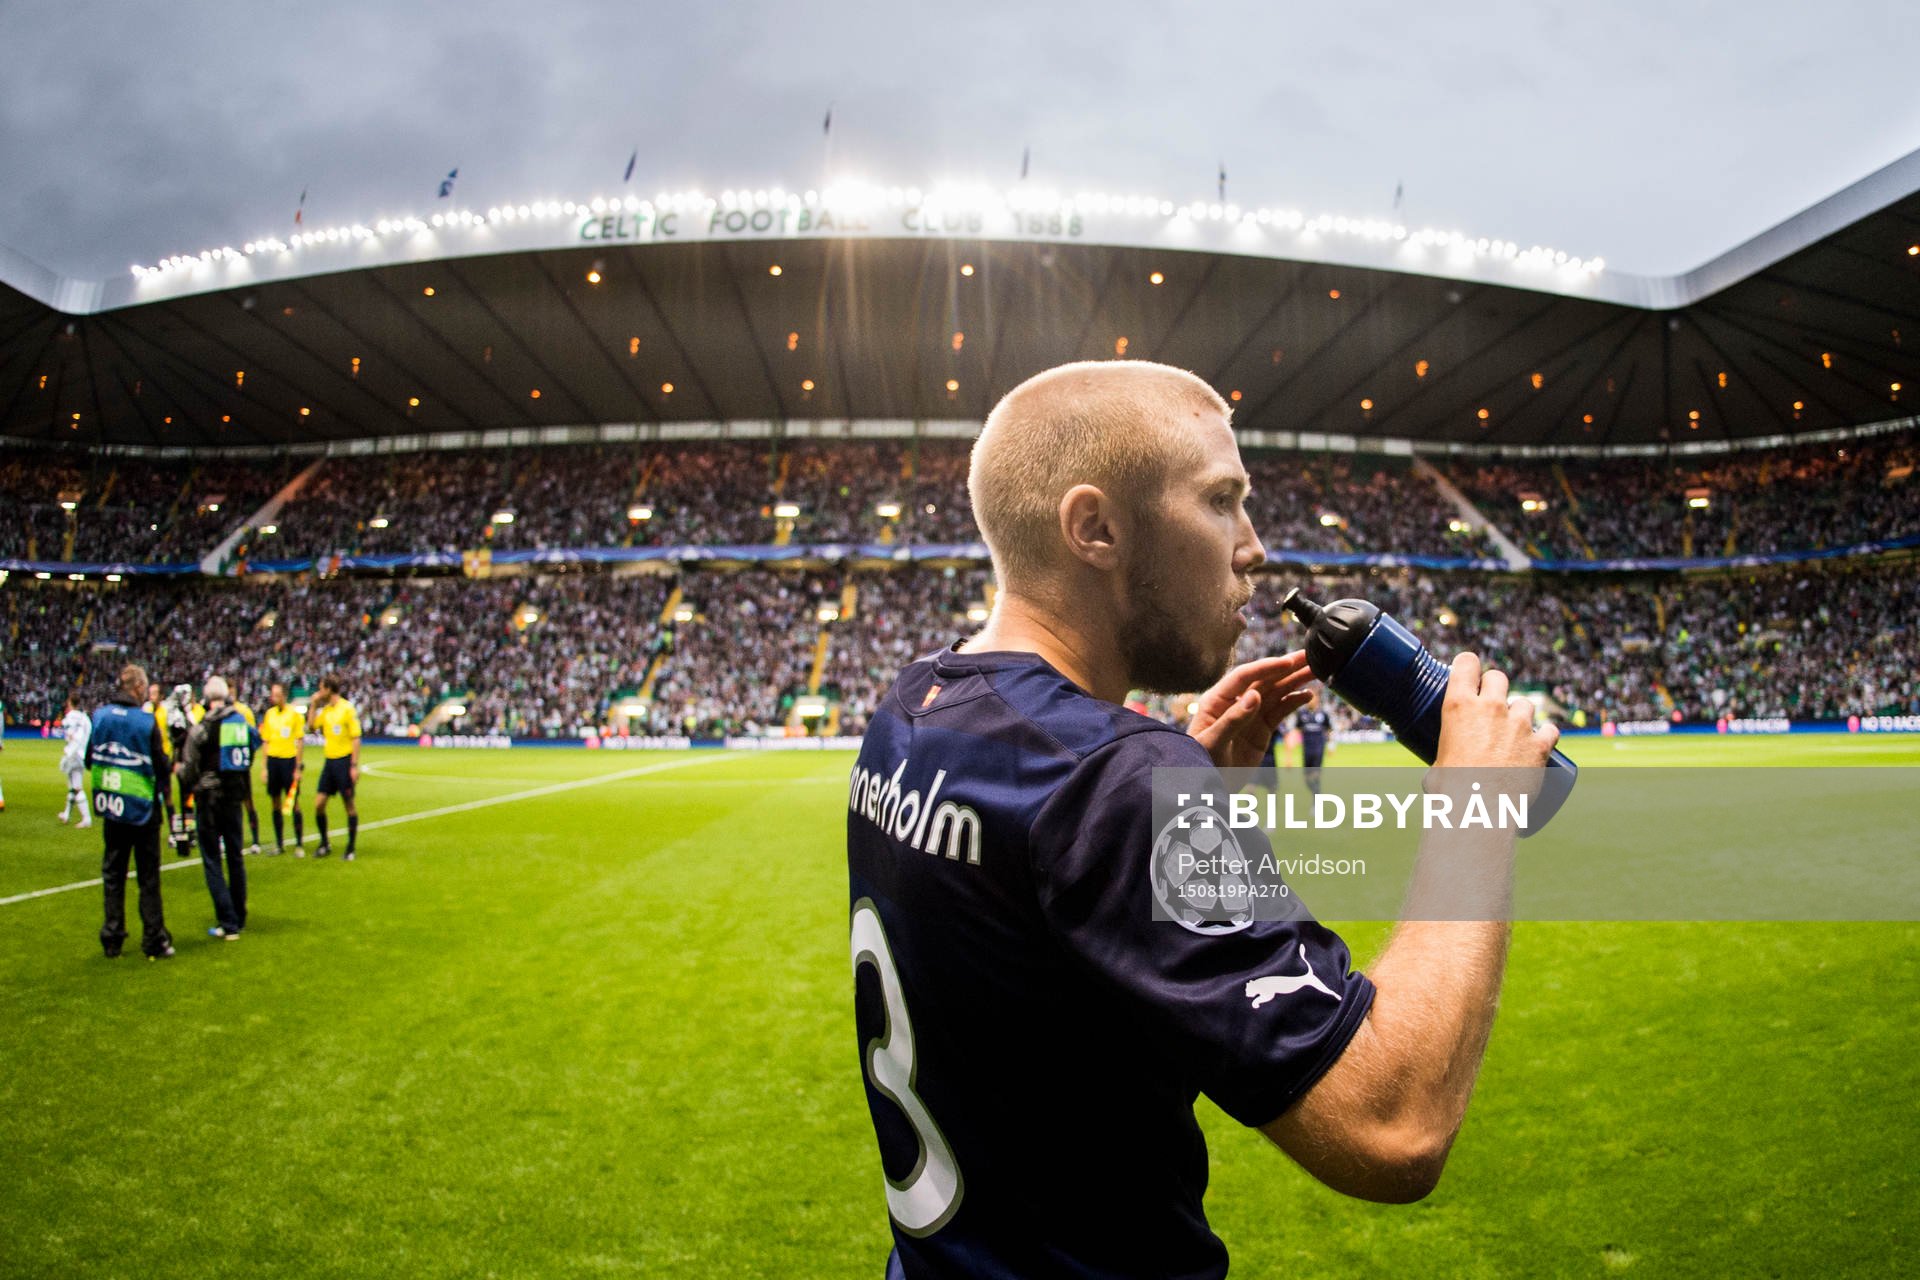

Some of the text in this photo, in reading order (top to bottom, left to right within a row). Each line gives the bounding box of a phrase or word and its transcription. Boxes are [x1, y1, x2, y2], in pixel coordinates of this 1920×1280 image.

[579, 213, 678, 241] CELTIC
[708, 208, 870, 234] FOOTBALL
[901, 207, 984, 233] CLUB
[95, 792, 124, 817] 040
[851, 897, 964, 1238] 3
